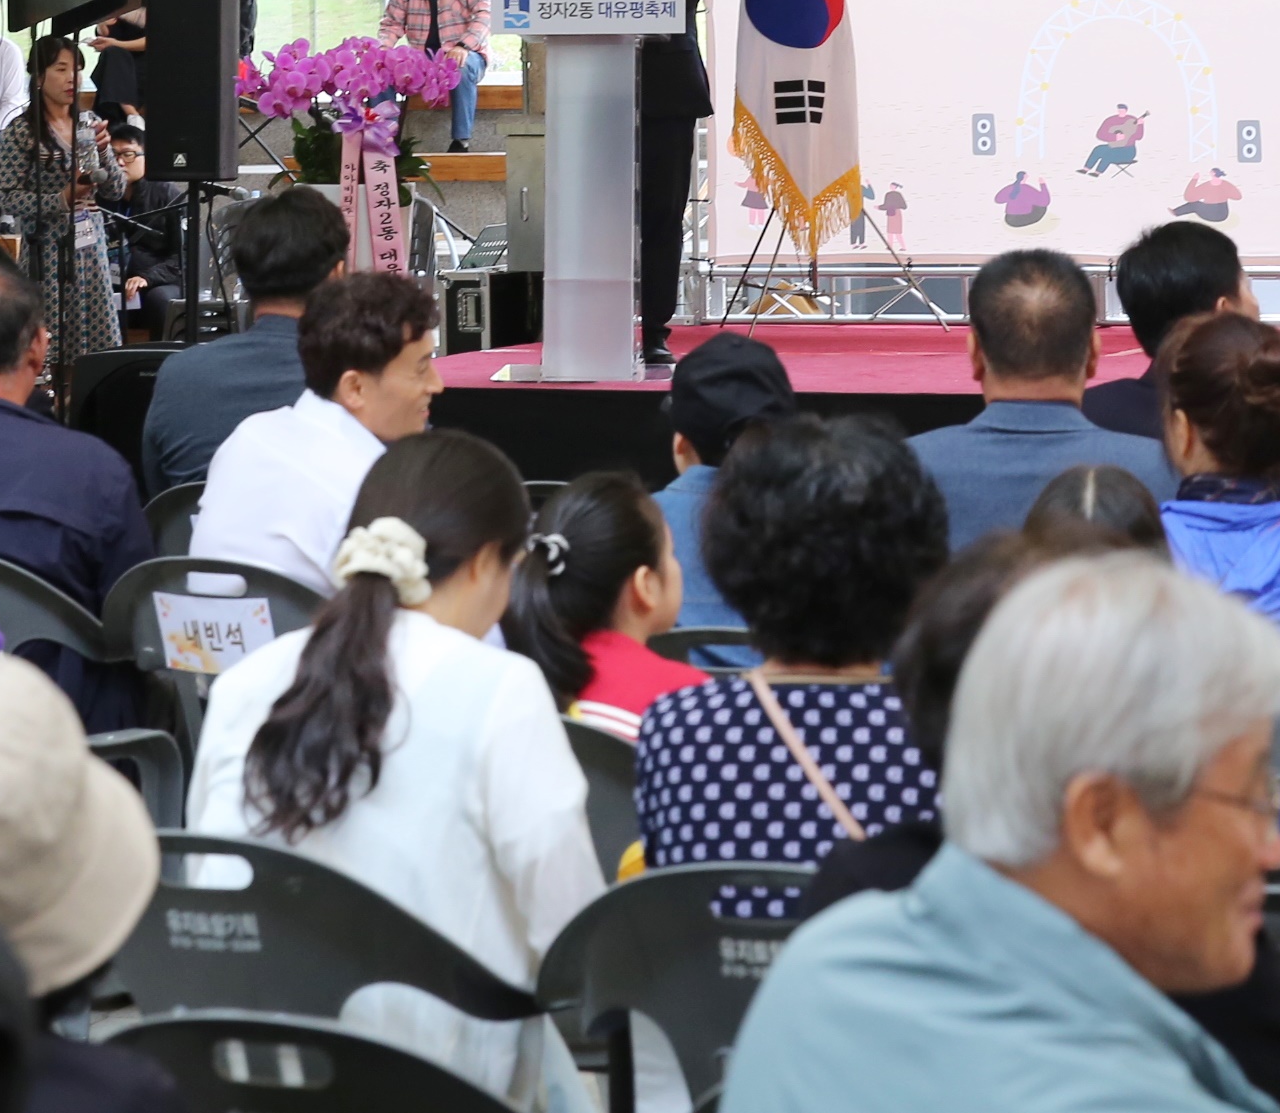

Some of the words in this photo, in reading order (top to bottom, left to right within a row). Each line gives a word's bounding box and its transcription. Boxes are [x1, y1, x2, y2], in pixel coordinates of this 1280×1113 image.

[537, 1, 594, 19] 정자2동
[598, 0, 676, 19] 대유평축제
[370, 160, 390, 174] 축
[373, 182, 398, 241] 정자2동
[183, 619, 246, 653] 내빈석
